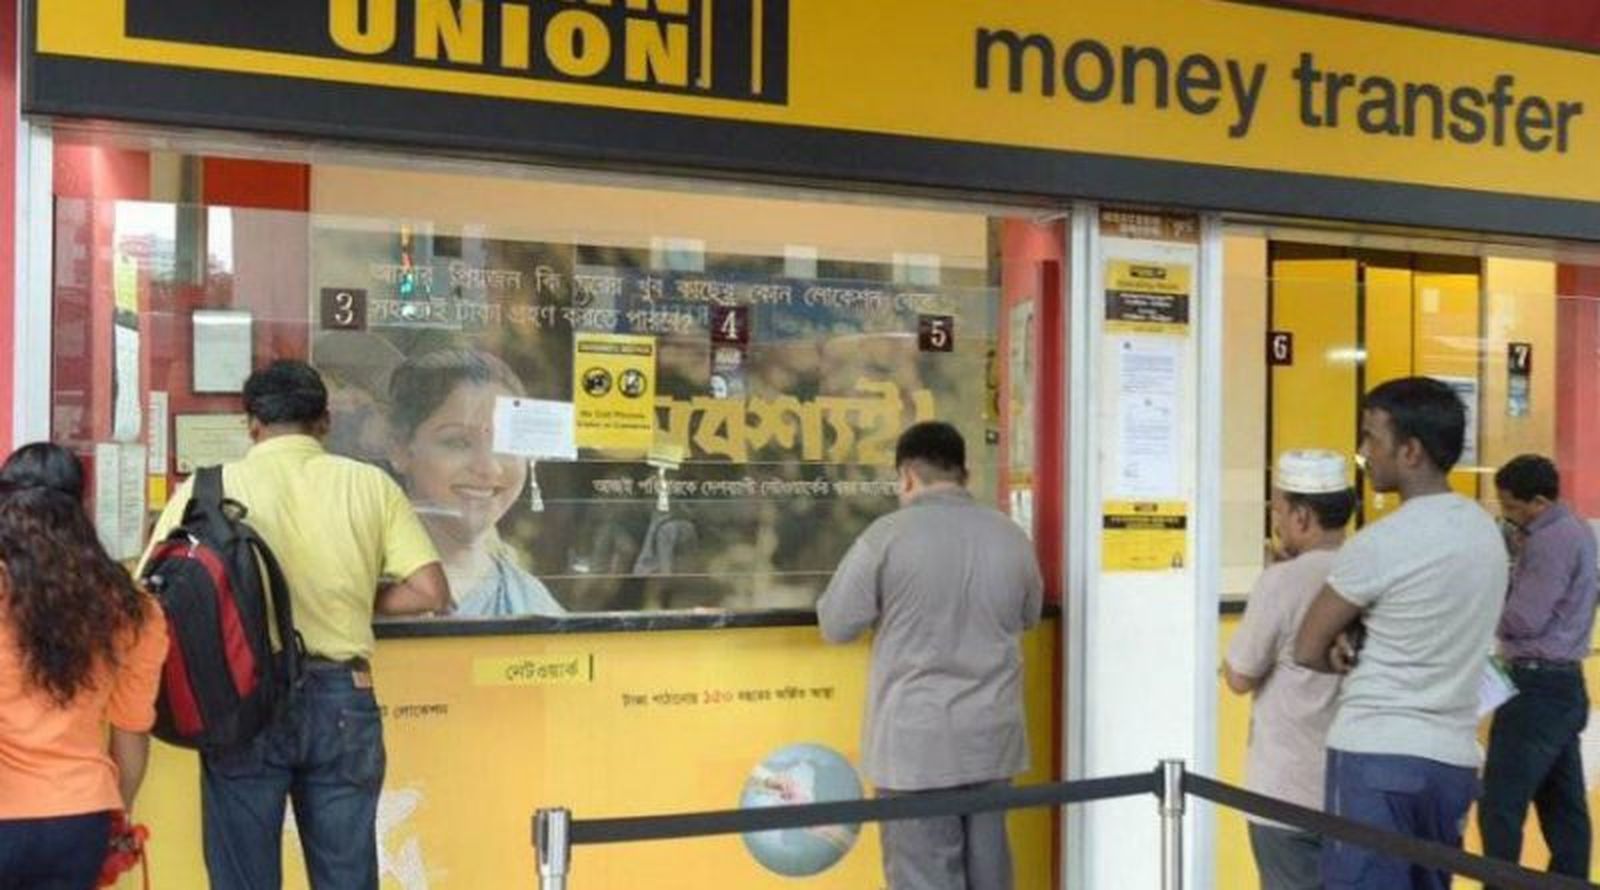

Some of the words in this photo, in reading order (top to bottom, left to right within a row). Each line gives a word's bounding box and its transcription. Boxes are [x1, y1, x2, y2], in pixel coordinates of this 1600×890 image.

[328, 0, 689, 87] UNION
[974, 27, 1267, 138] money
[1292, 52, 1583, 154] transfer
[335, 292, 353, 326] 3
[720, 310, 738, 340] 4
[930, 320, 948, 348] 5
[1273, 335, 1288, 360] 6
[1514, 345, 1529, 368] 7
